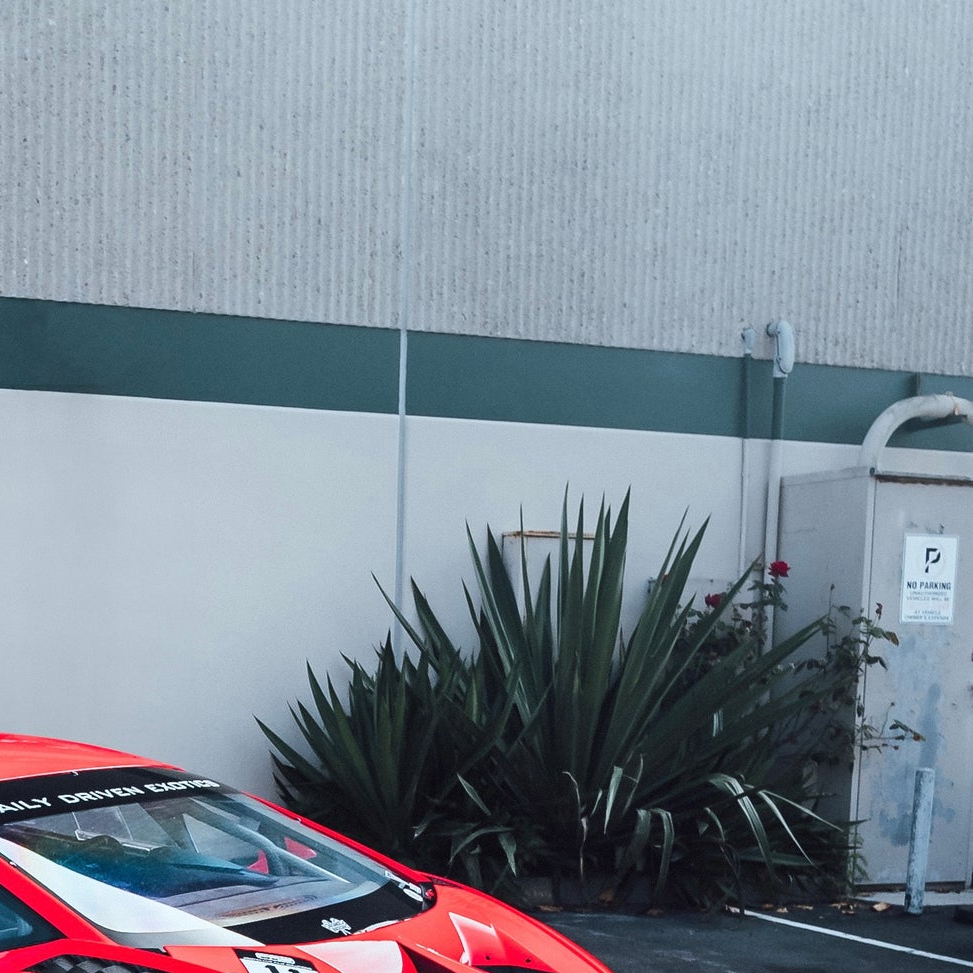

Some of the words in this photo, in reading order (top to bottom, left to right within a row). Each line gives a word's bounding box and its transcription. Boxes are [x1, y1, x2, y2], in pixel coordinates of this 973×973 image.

[907, 581, 917, 589] NO
[920, 582, 951, 590] PARKING
[57, 786, 145, 804] DRIVEN
[143, 779, 221, 794] EXOTICS
